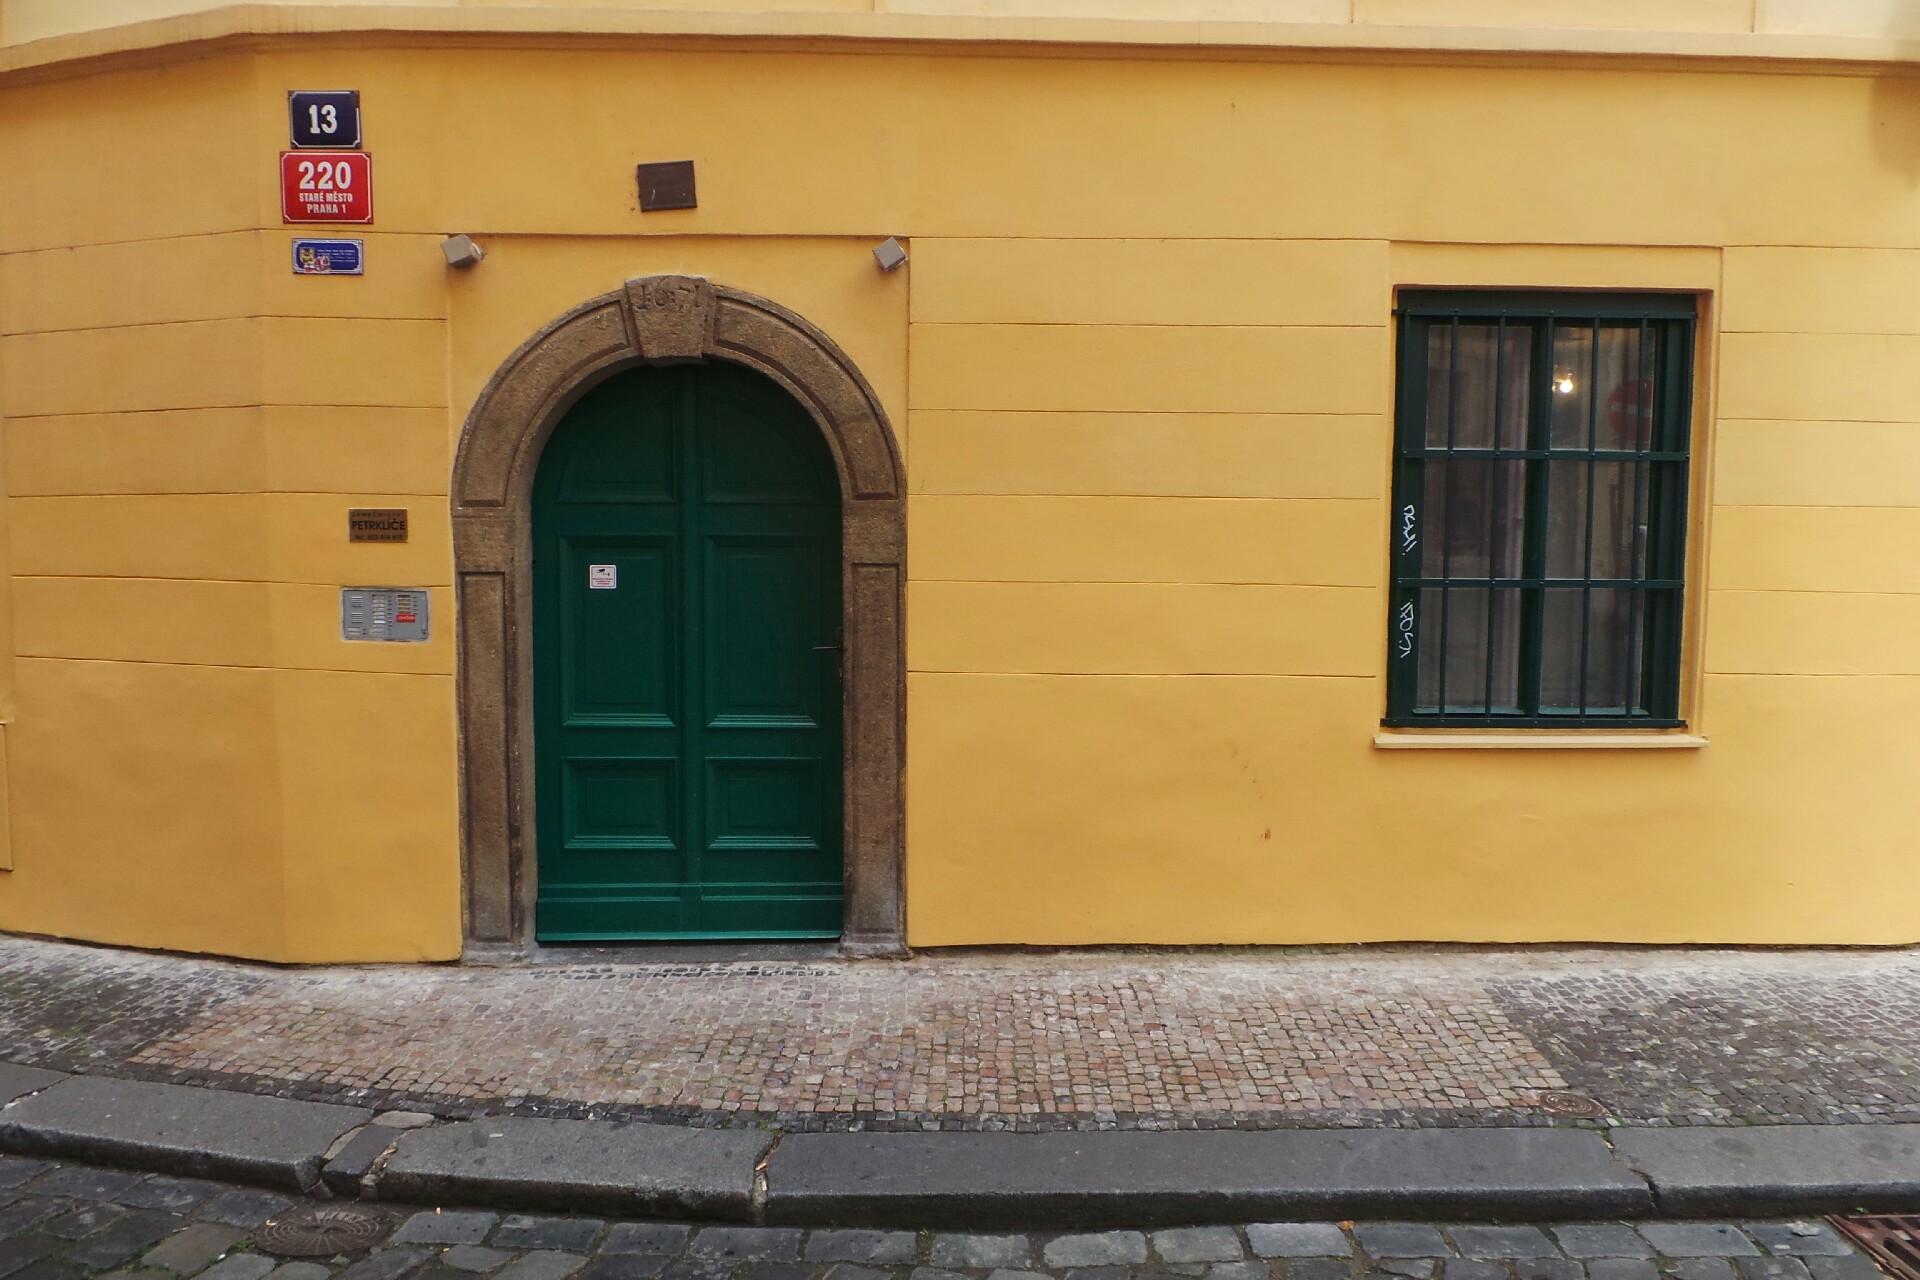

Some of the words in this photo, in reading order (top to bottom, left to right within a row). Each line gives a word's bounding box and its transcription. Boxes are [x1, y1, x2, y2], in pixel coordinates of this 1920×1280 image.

[309, 104, 337, 134] 13
[298, 161, 352, 190] 220
[299, 191, 324, 202] STARÉ
[326, 191, 353, 202] MĚSTO
[307, 204, 339, 214] PRAHA
[342, 204, 347, 214] 1
